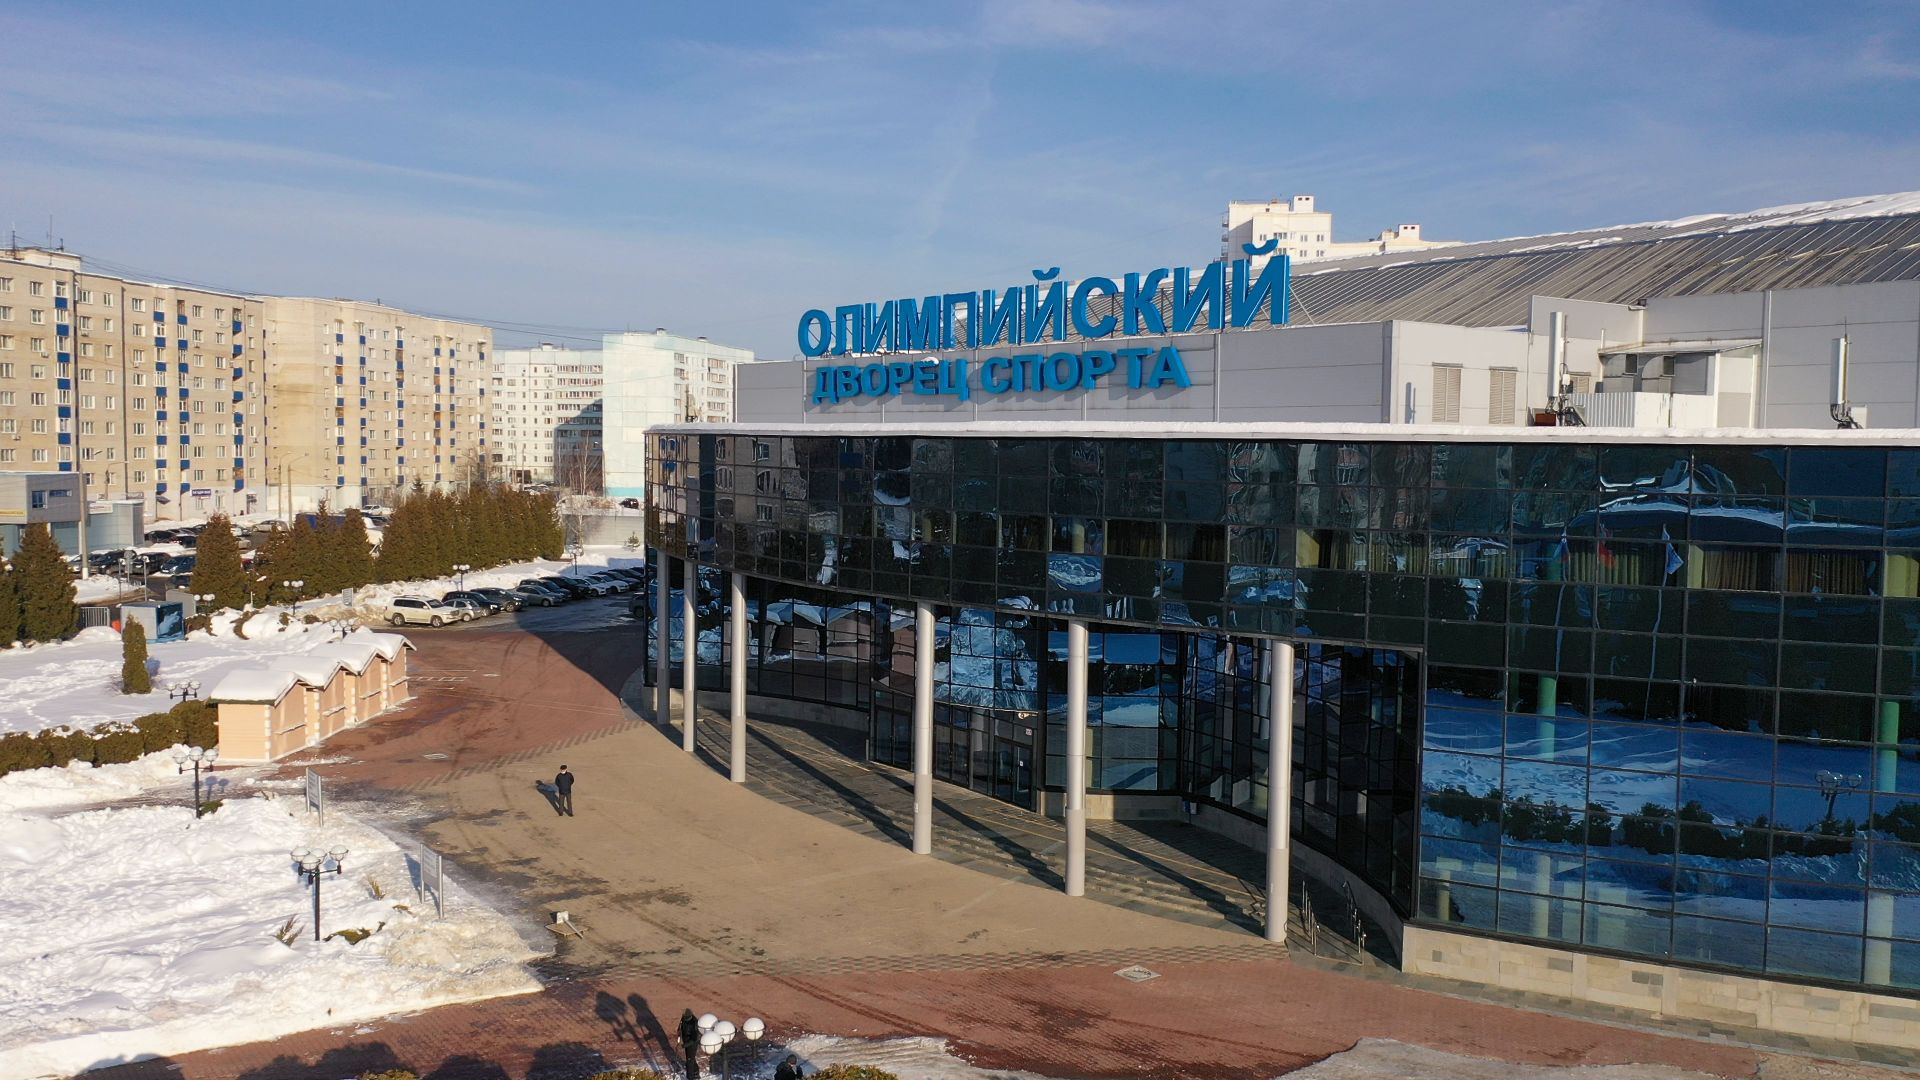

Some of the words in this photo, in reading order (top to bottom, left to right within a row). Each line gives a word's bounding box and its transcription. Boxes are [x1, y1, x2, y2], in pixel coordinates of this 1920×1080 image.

[798, 239, 1290, 357] ОЛИМПИЙСКИЙ
[812, 358, 970, 405] ДВОРЕЦ
[980, 346, 1192, 394] СПОРТА
